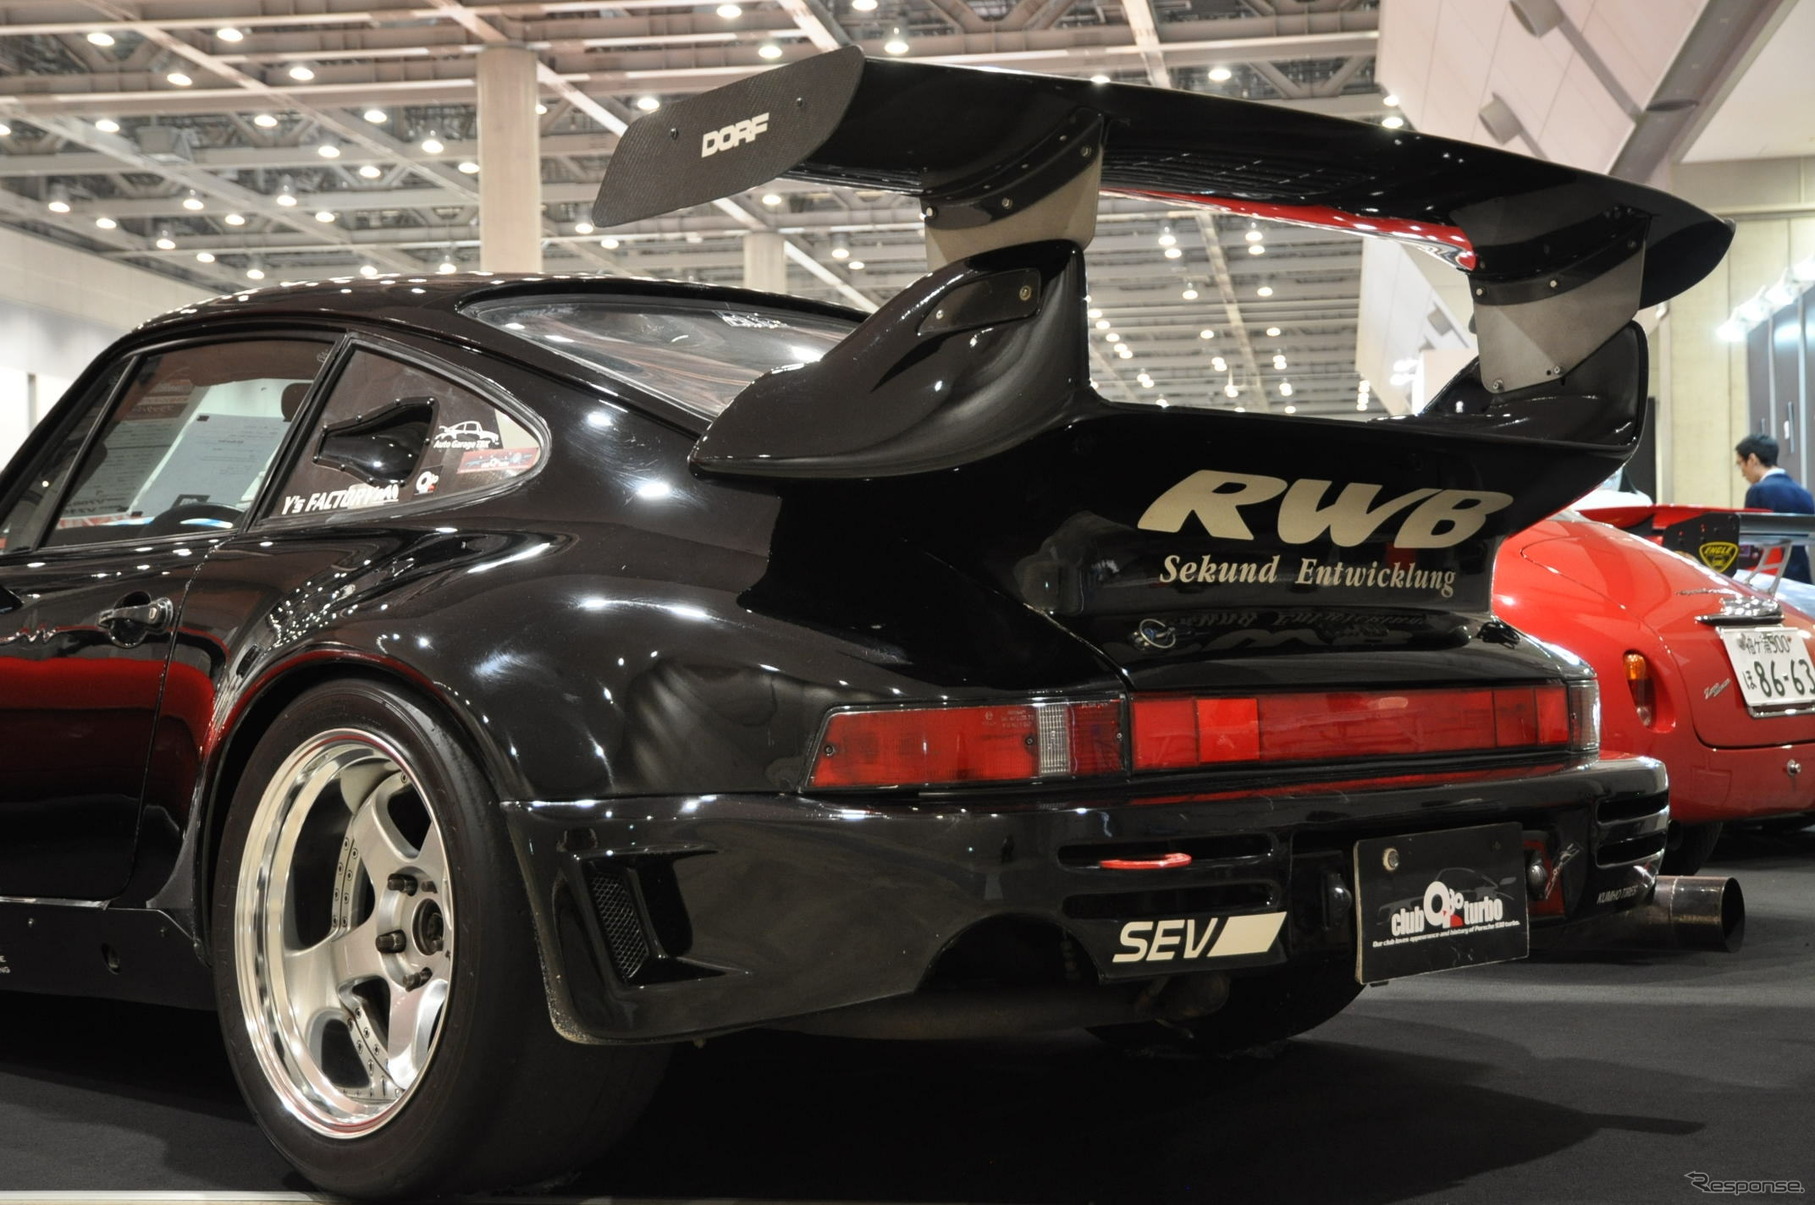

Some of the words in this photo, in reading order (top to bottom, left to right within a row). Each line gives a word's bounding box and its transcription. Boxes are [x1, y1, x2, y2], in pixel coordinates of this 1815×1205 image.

[701, 112, 770, 158] DORF
[281, 495, 306, 515] Y's
[1137, 469, 1515, 549] RWB
[1159, 553, 1281, 584] Sekund
[1295, 557, 1456, 598] Entwicklung
[1372, 940, 1383, 948] Our
[1383, 938, 1395, 946] club
[1439, 930, 1450, 938] and
[1391, 905, 1425, 937] club
[1463, 896, 1504, 926] turbo
[1111, 917, 1218, 964] SEV
